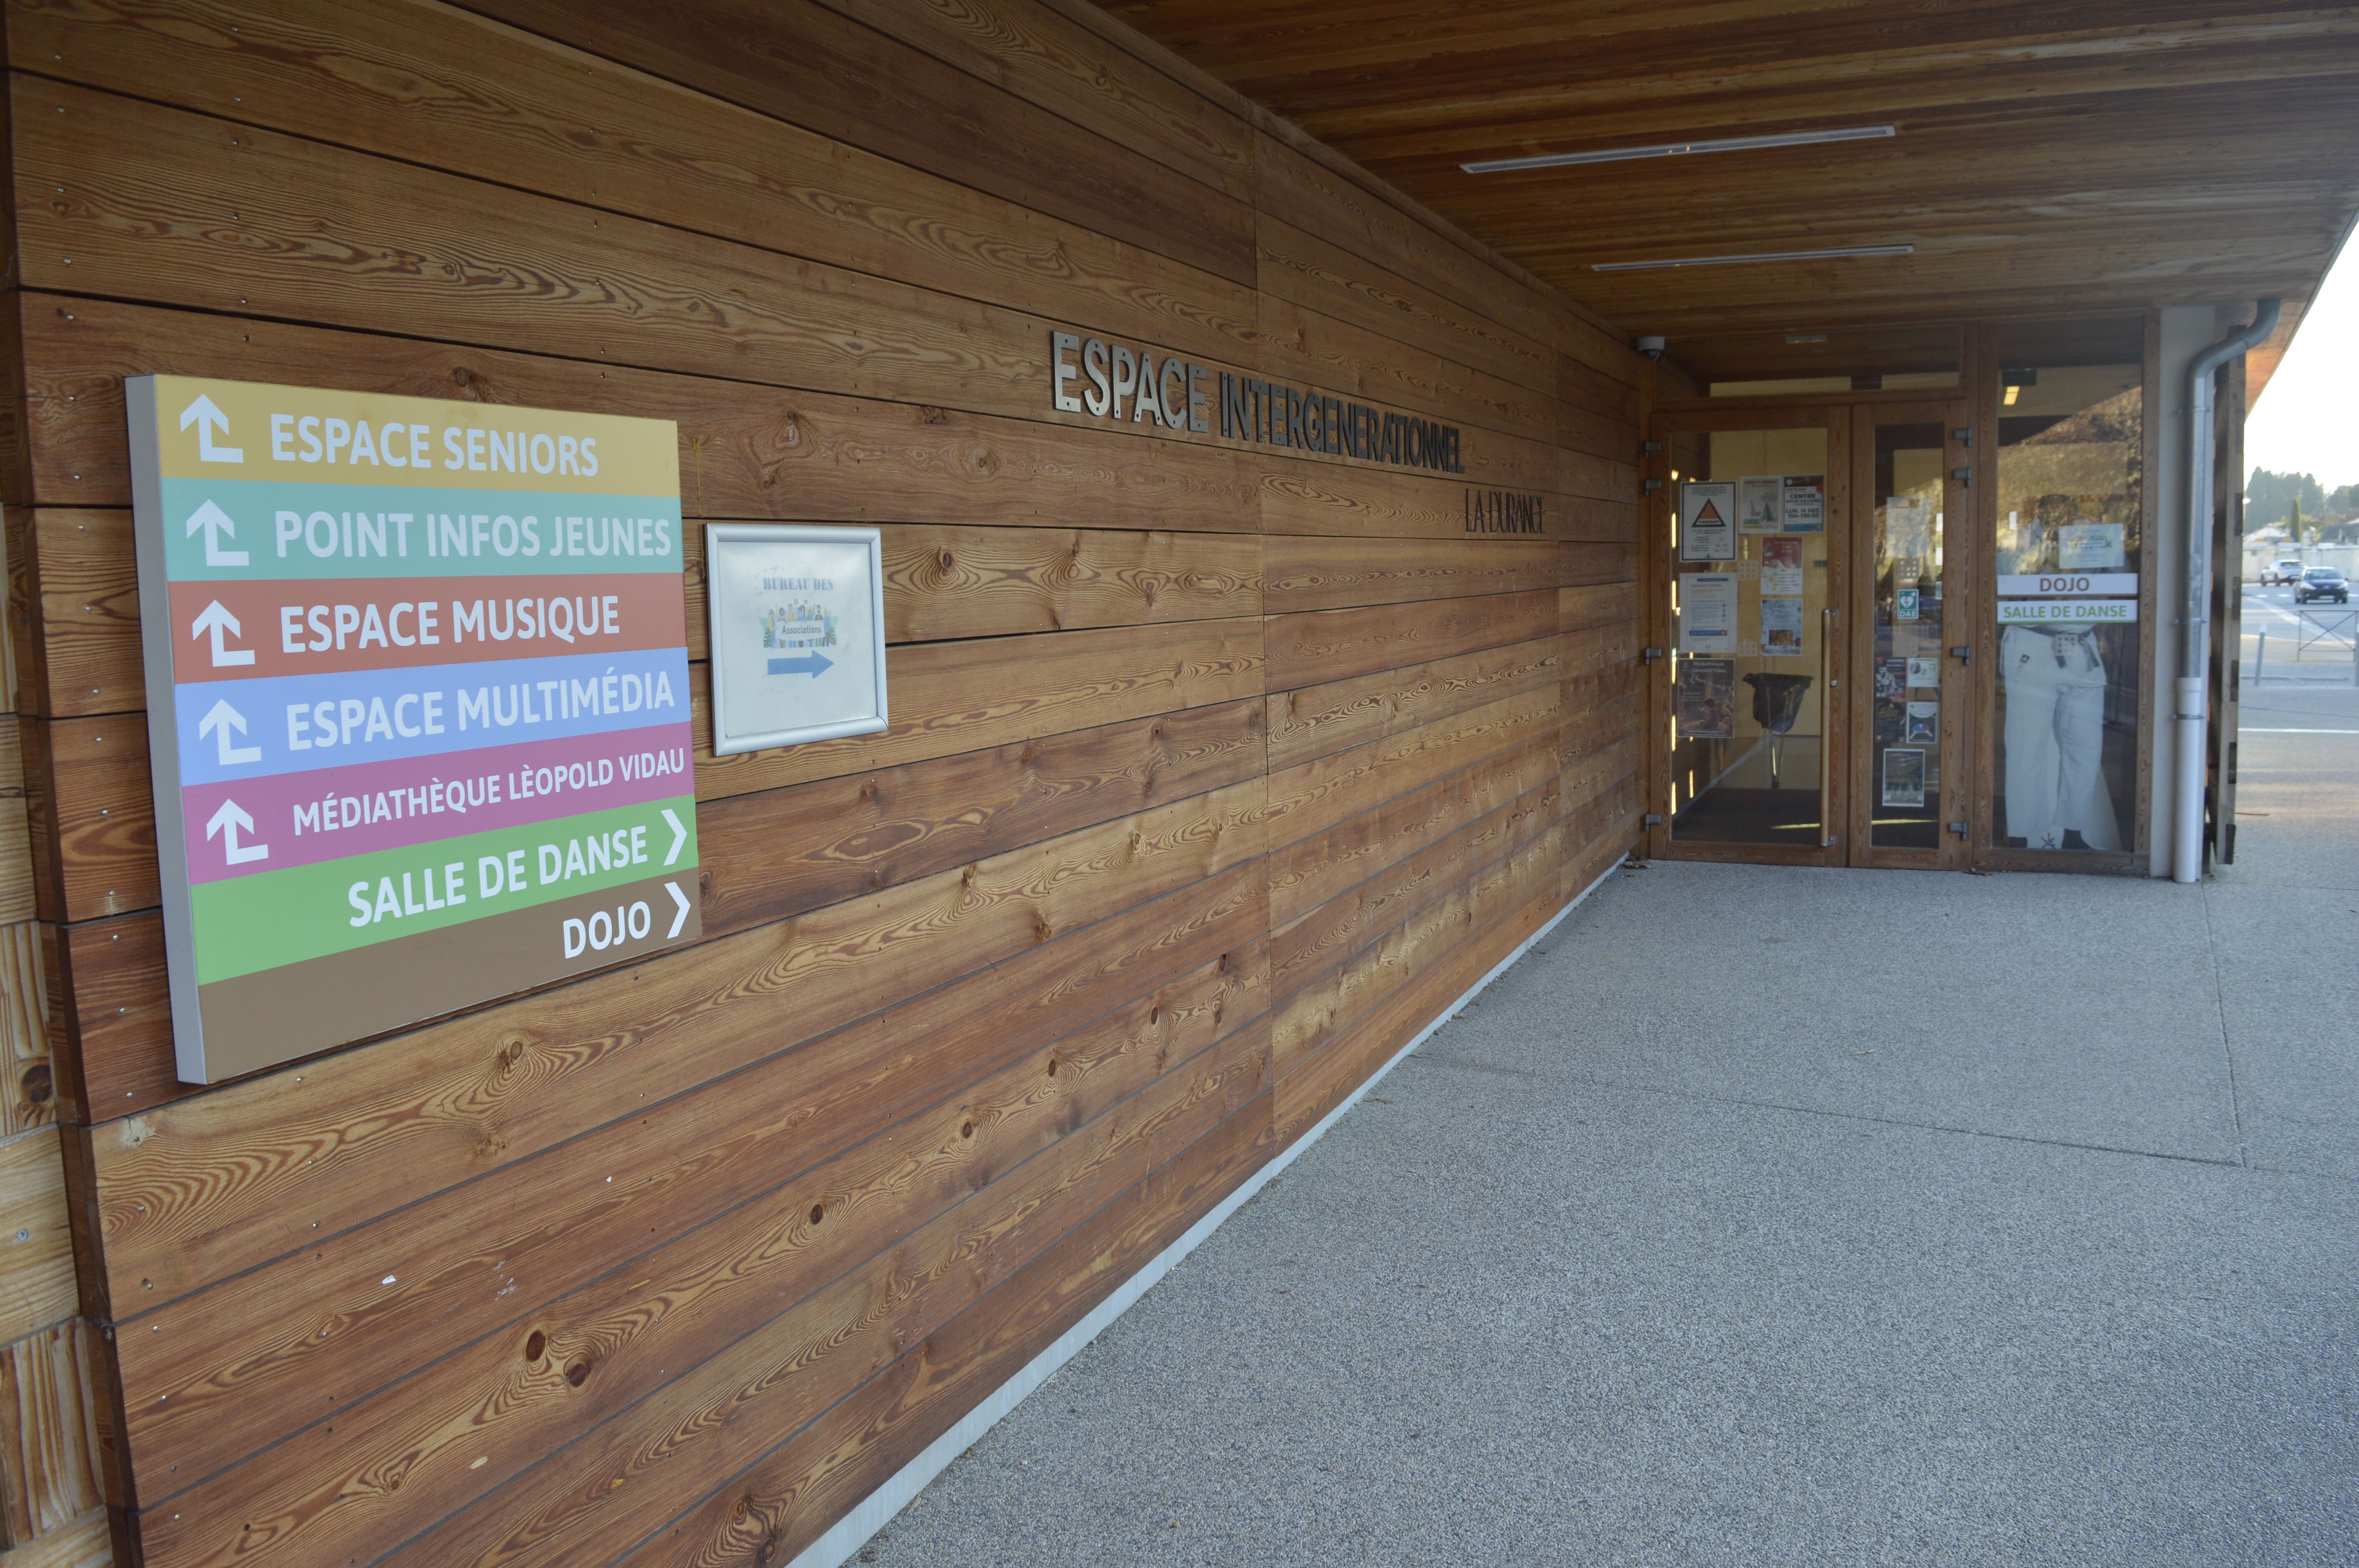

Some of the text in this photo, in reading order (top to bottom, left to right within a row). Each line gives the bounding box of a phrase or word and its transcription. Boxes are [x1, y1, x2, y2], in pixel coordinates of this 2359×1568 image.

[1053, 331, 1465, 474] ESPACE INTERGENERATIONNEL
[271, 413, 598, 477] ESPACE SENIORS
[275, 510, 671, 557] POINT INFOS JEUNES
[1466, 488, 1546, 534] LA DURANCE
[763, 577, 834, 590] BUREAU DES
[2004, 605, 2126, 618] SALLE DE DANSE
[2039, 577, 2090, 592] DOJO
[281, 596, 620, 653] ESPACE MUSIQUE
[781, 625, 822, 635] Associations
[287, 667, 674, 751] ESPACE MULTIMÉDIA
[293, 748, 685, 835] MÉDIATHÈQUE LÈOPOLD VIDAU
[348, 825, 648, 927] SALLE DE DANSE
[563, 901, 651, 959] DOJO
